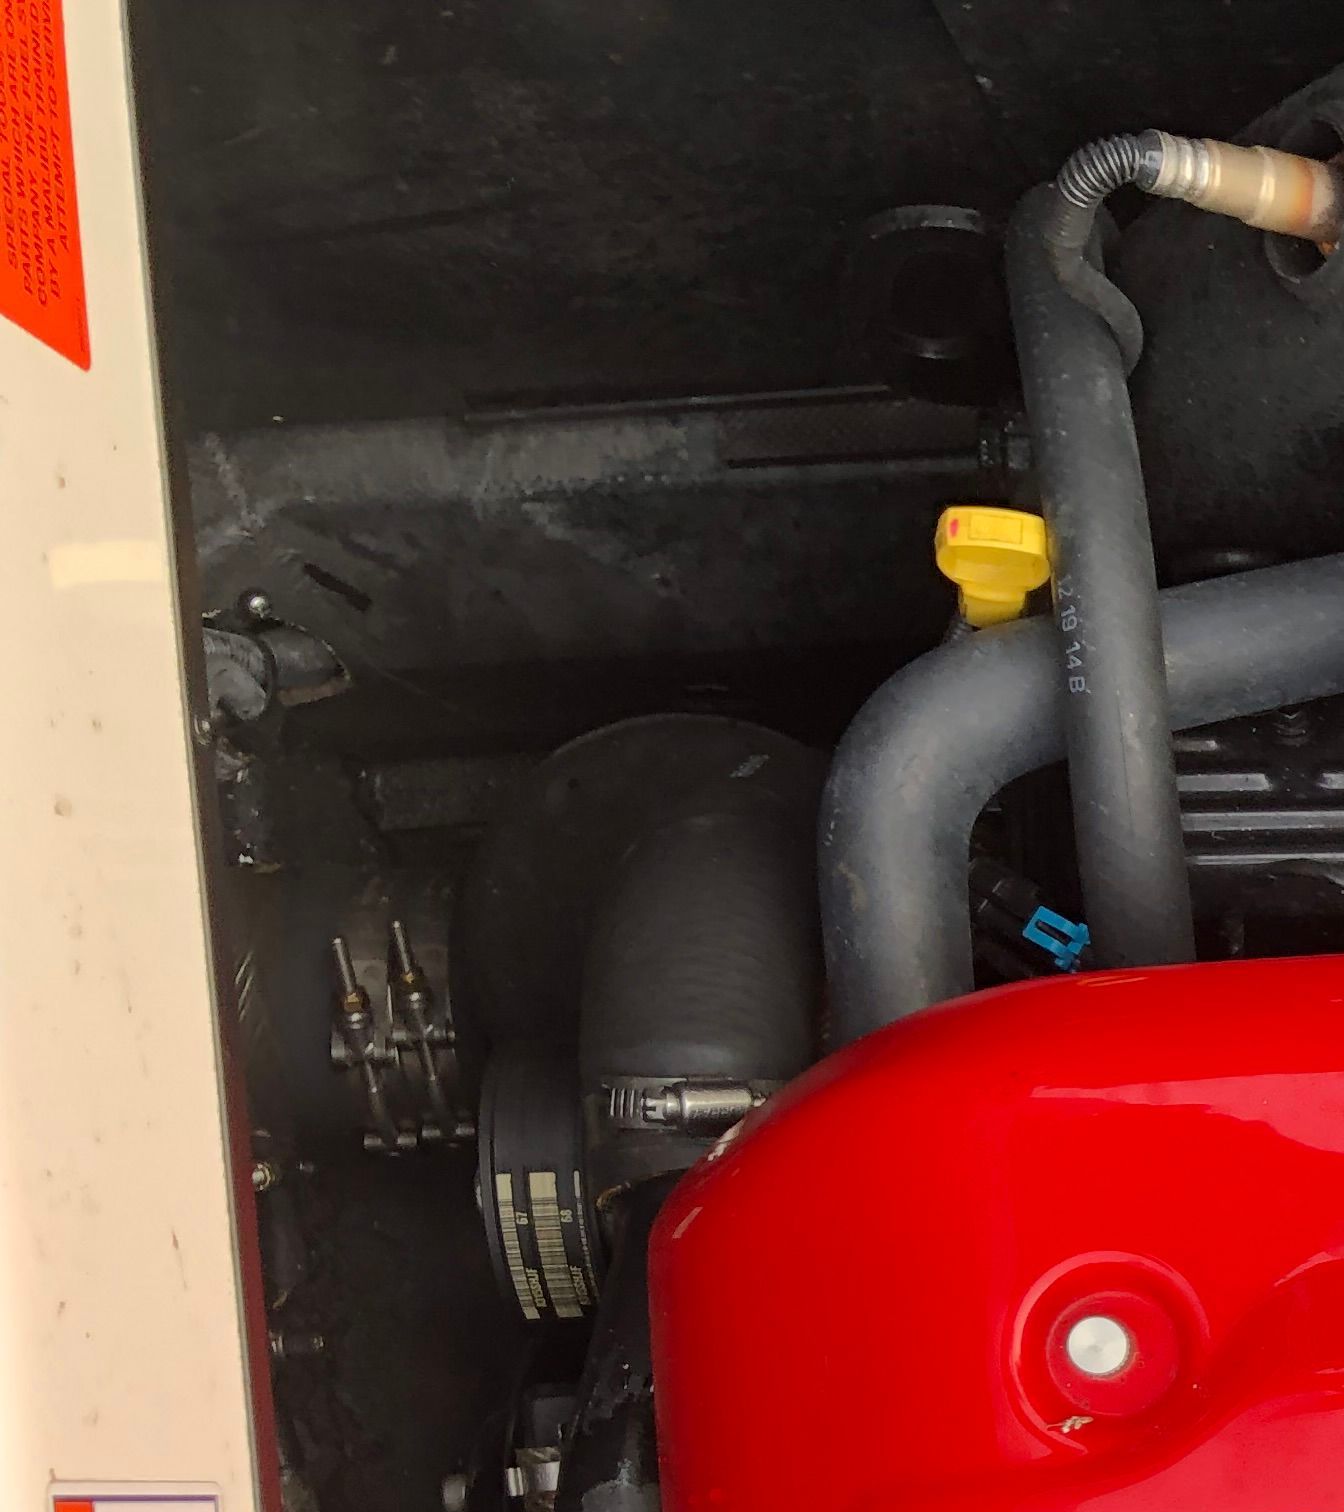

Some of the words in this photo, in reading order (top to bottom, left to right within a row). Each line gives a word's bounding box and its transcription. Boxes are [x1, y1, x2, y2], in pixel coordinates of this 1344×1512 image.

[19, 36, 32, 100] FUEL
[30, 2, 46, 116] TRAINED
[48, 85, 58, 119] TO
[11, 106, 26, 199] WHICH
[24, 105, 36, 158] THE
[38, 125, 55, 230] MALIBU
[50, 126, 69, 253] ATTEMPT
[18, 208, 33, 296] PARTS
